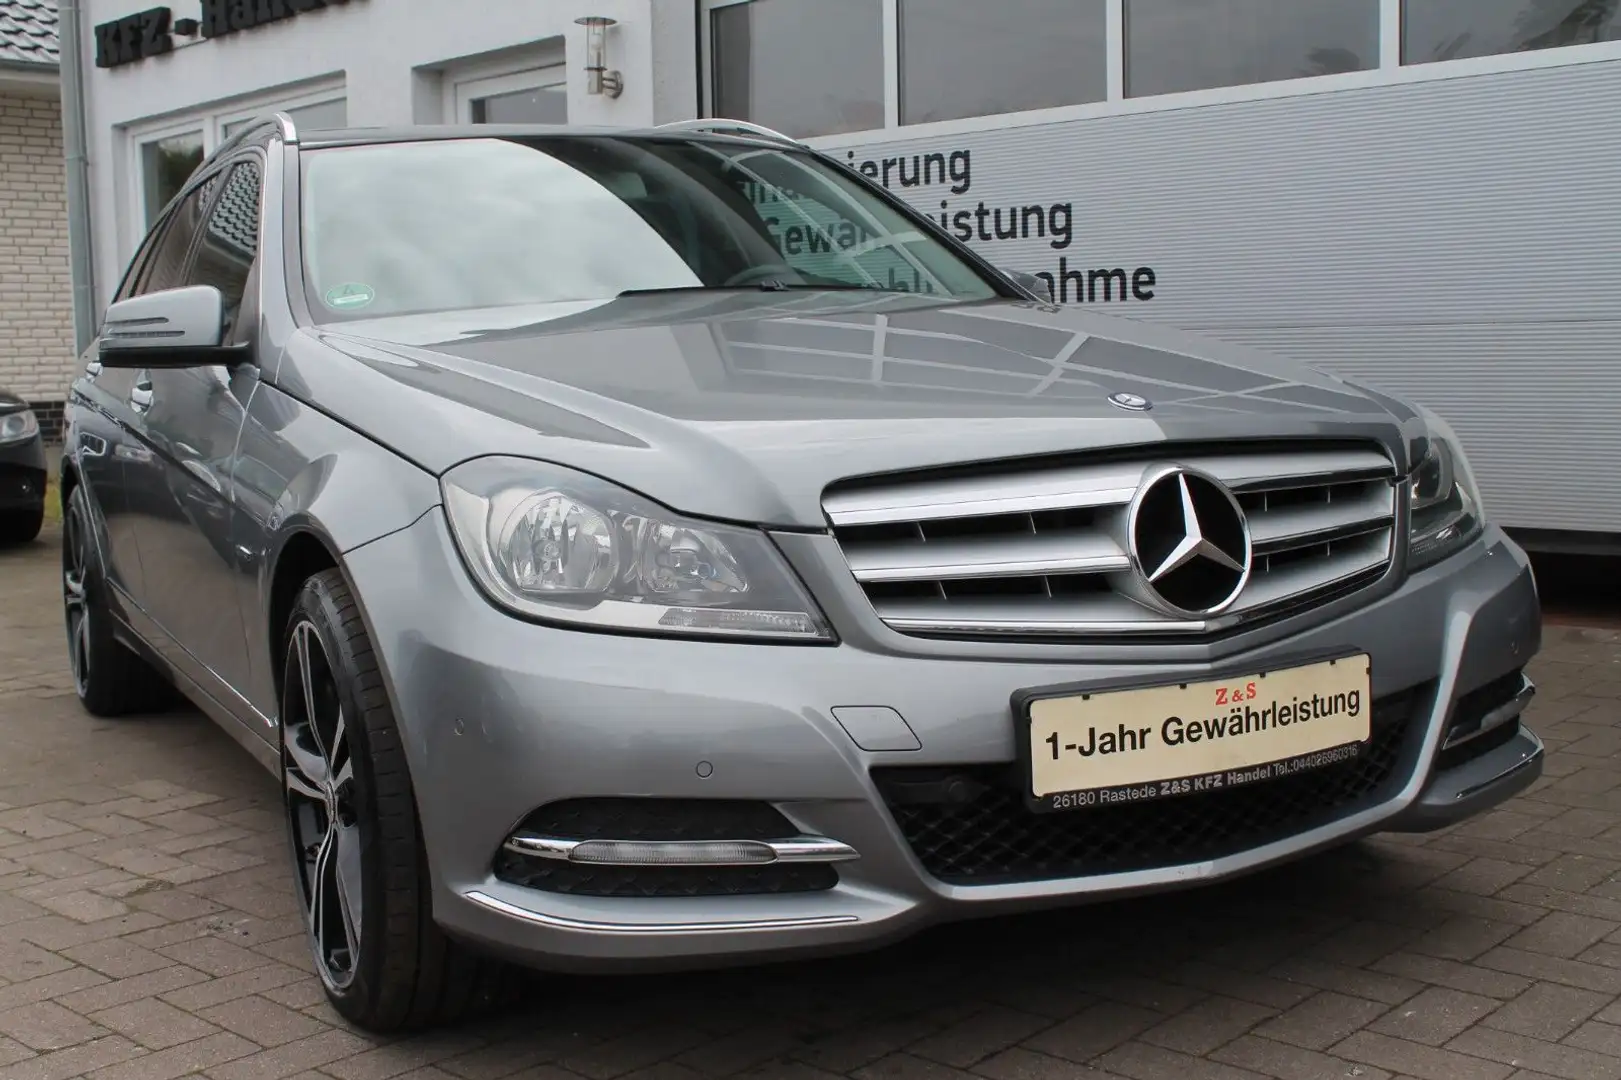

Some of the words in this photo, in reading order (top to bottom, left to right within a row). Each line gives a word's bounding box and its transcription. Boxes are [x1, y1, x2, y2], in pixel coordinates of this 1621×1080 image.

[924, 199, 1073, 250] istung
[1045, 723, 1152, 760] 1-Jahr
[1161, 689, 1360, 746] Gewährleistung
[1053, 791, 1096, 809] 26180
[1100, 785, 1157, 803] Rastede
[1160, 778, 1191, 796] Z&S
[1194, 773, 1223, 791] KFZ
[1227, 764, 1271, 785] Handel
